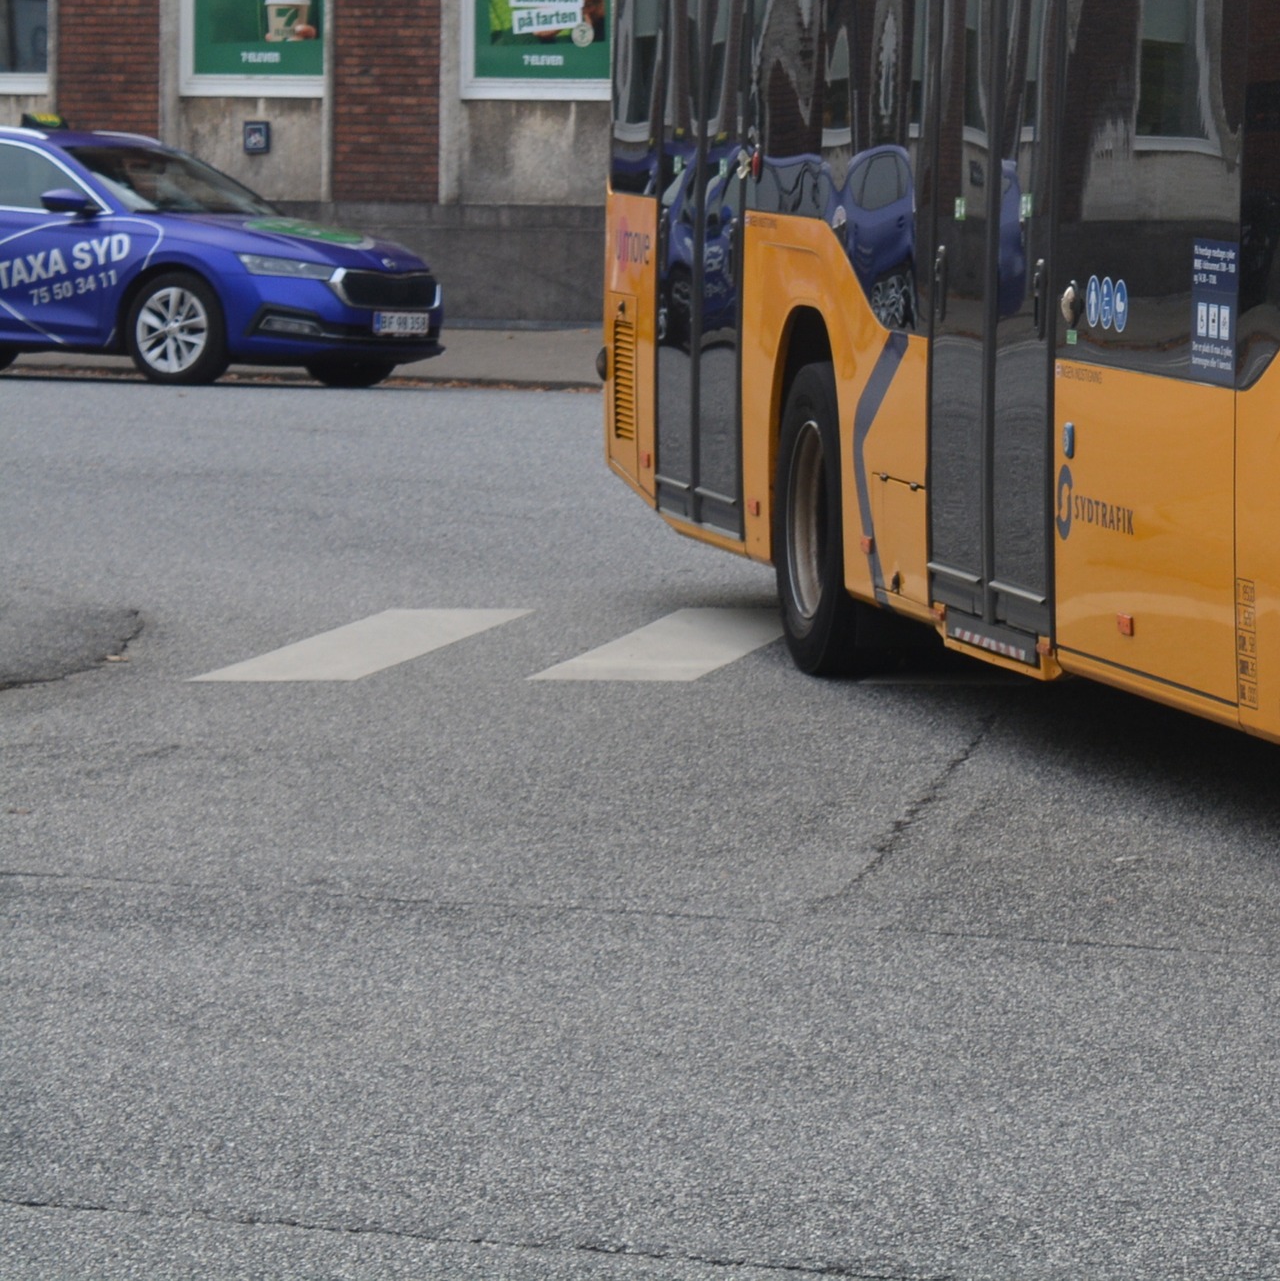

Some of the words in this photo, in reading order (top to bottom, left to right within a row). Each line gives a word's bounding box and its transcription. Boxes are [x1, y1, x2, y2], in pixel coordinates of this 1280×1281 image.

[517, 10, 534, 31] på
[536, 9, 577, 26] farten
[522, 54, 564, 66] 7-ELEVEN
[0, 248, 68, 290] TAXA
[72, 232, 131, 270] SYD
[29, 286, 51, 306] 75
[52, 280, 74, 300] 50
[75, 275, 97, 295] 34
[98, 269, 118, 288] 11
[1074, 494, 1134, 536] SYDTRAFIK
